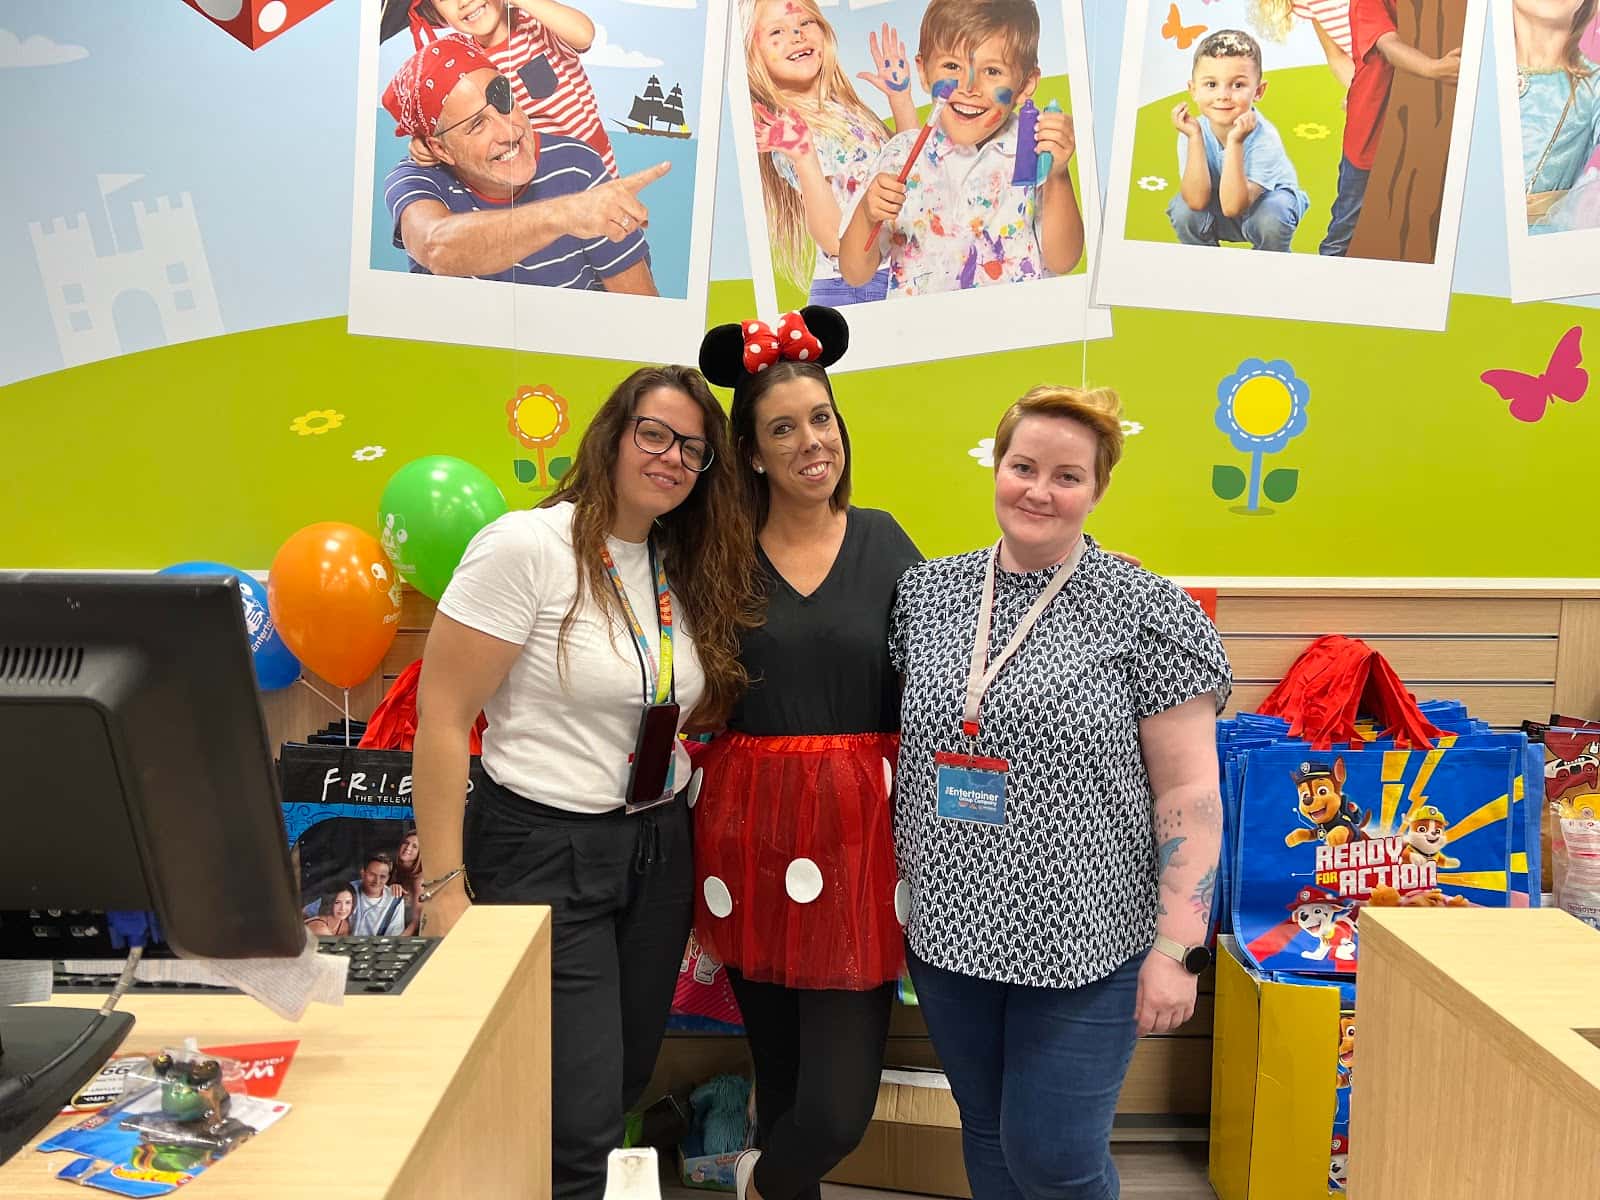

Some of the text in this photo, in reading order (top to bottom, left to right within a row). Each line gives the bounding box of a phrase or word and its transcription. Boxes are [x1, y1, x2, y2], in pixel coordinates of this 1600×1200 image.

[250, 619, 274, 653] Enterta
[355, 794, 412, 804] THE TELEVI
[1316, 861, 1437, 896] FOR ACTION
